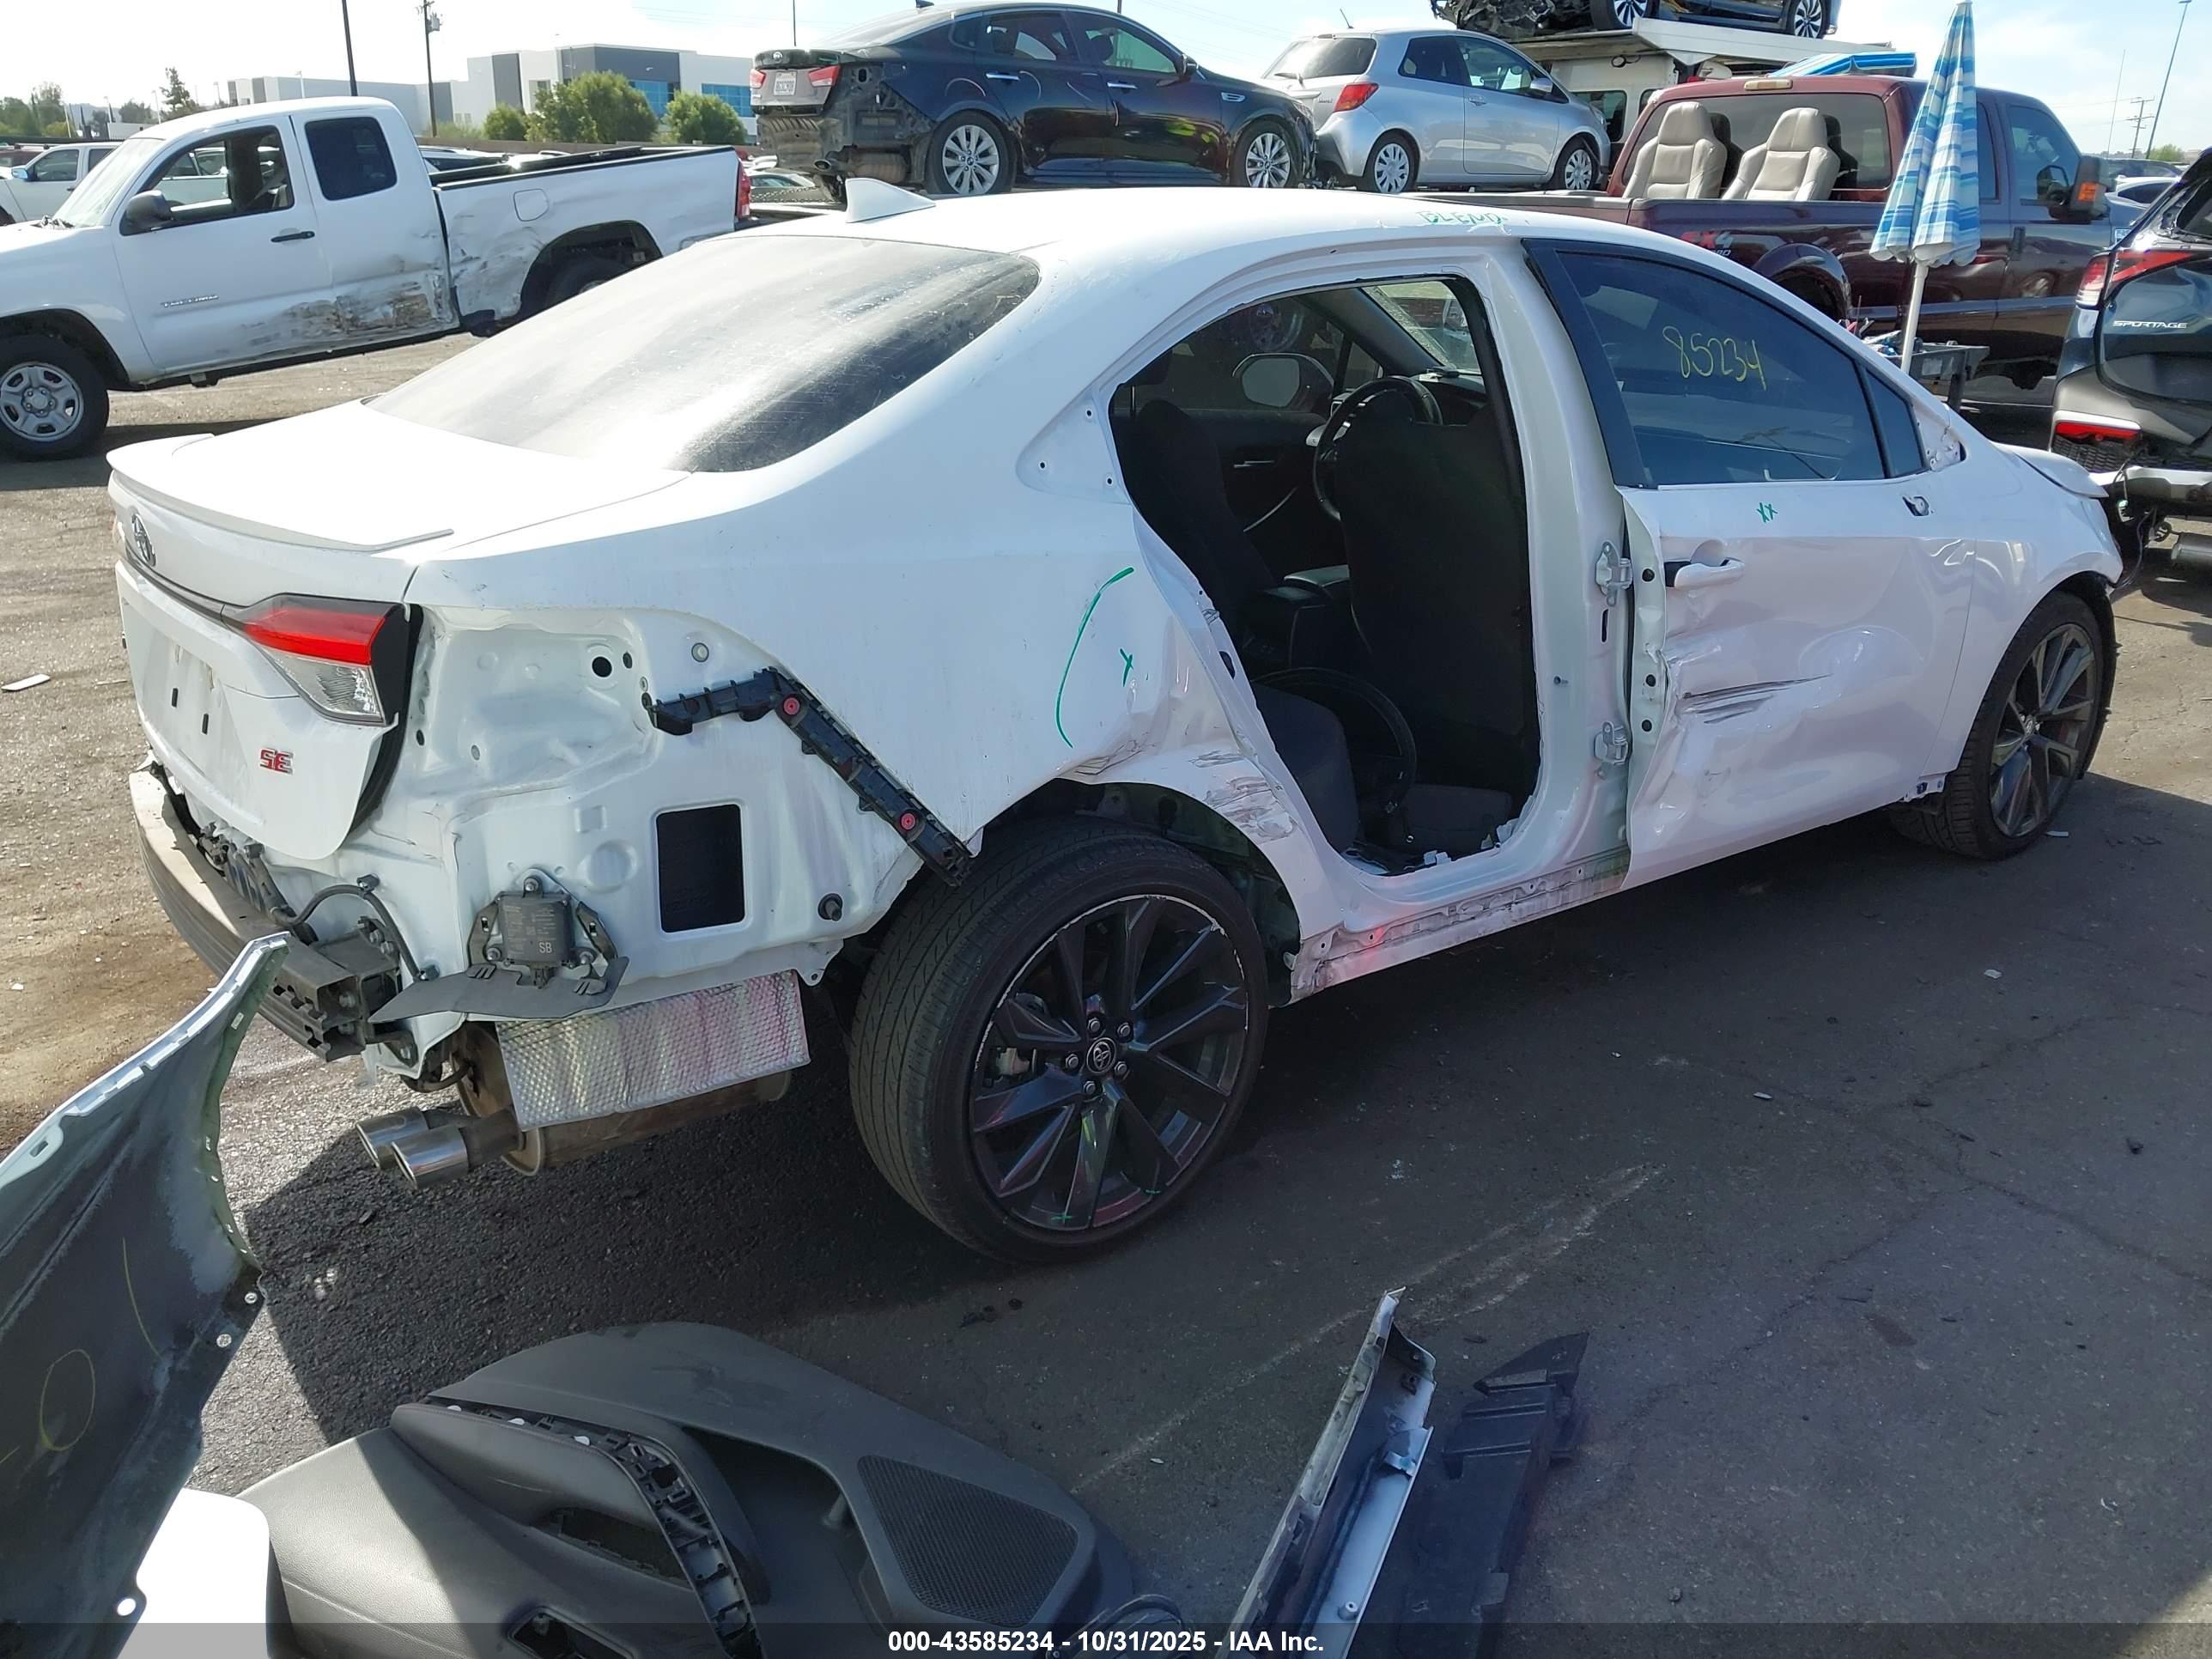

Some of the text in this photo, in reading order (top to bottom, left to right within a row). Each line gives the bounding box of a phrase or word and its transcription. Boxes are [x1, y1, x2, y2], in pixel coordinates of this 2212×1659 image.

[2112, 319, 2188, 329] SPORTAGE
[1662, 325, 1767, 391] 85234
[259, 747, 294, 775] SE
[538, 942, 552, 953] SB
